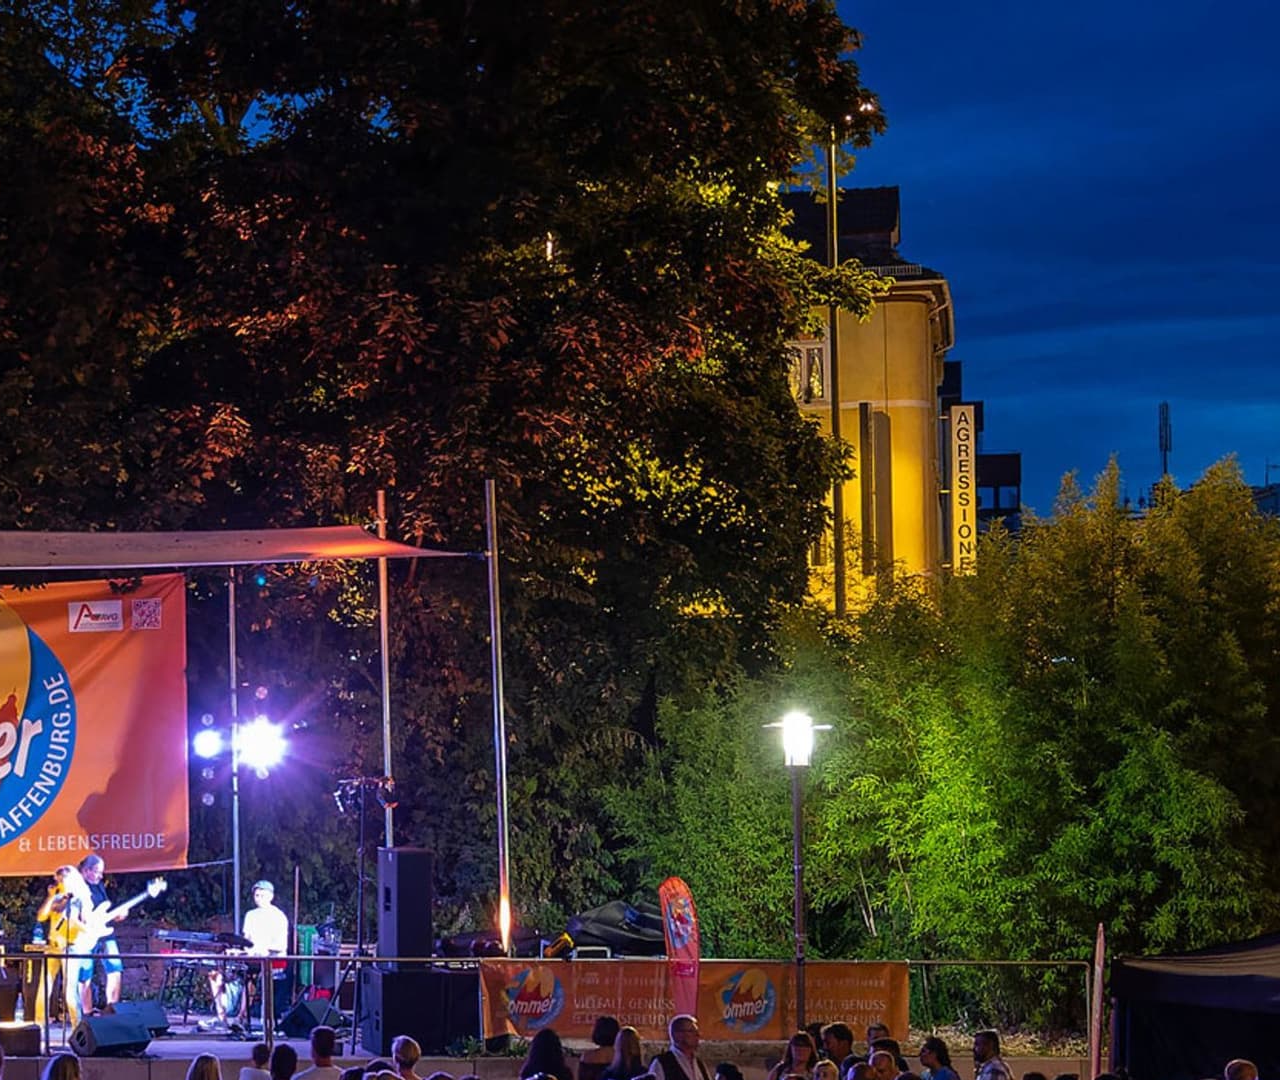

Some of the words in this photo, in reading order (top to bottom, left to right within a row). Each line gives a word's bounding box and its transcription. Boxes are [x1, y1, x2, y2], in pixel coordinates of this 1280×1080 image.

[956, 411, 972, 571] AGRESSIONE
[18, 837, 31, 852] &
[38, 832, 166, 851] LEBENSFREUDE
[629, 998, 675, 1010] GENUSS
[841, 999, 886, 1010] GENUSS
